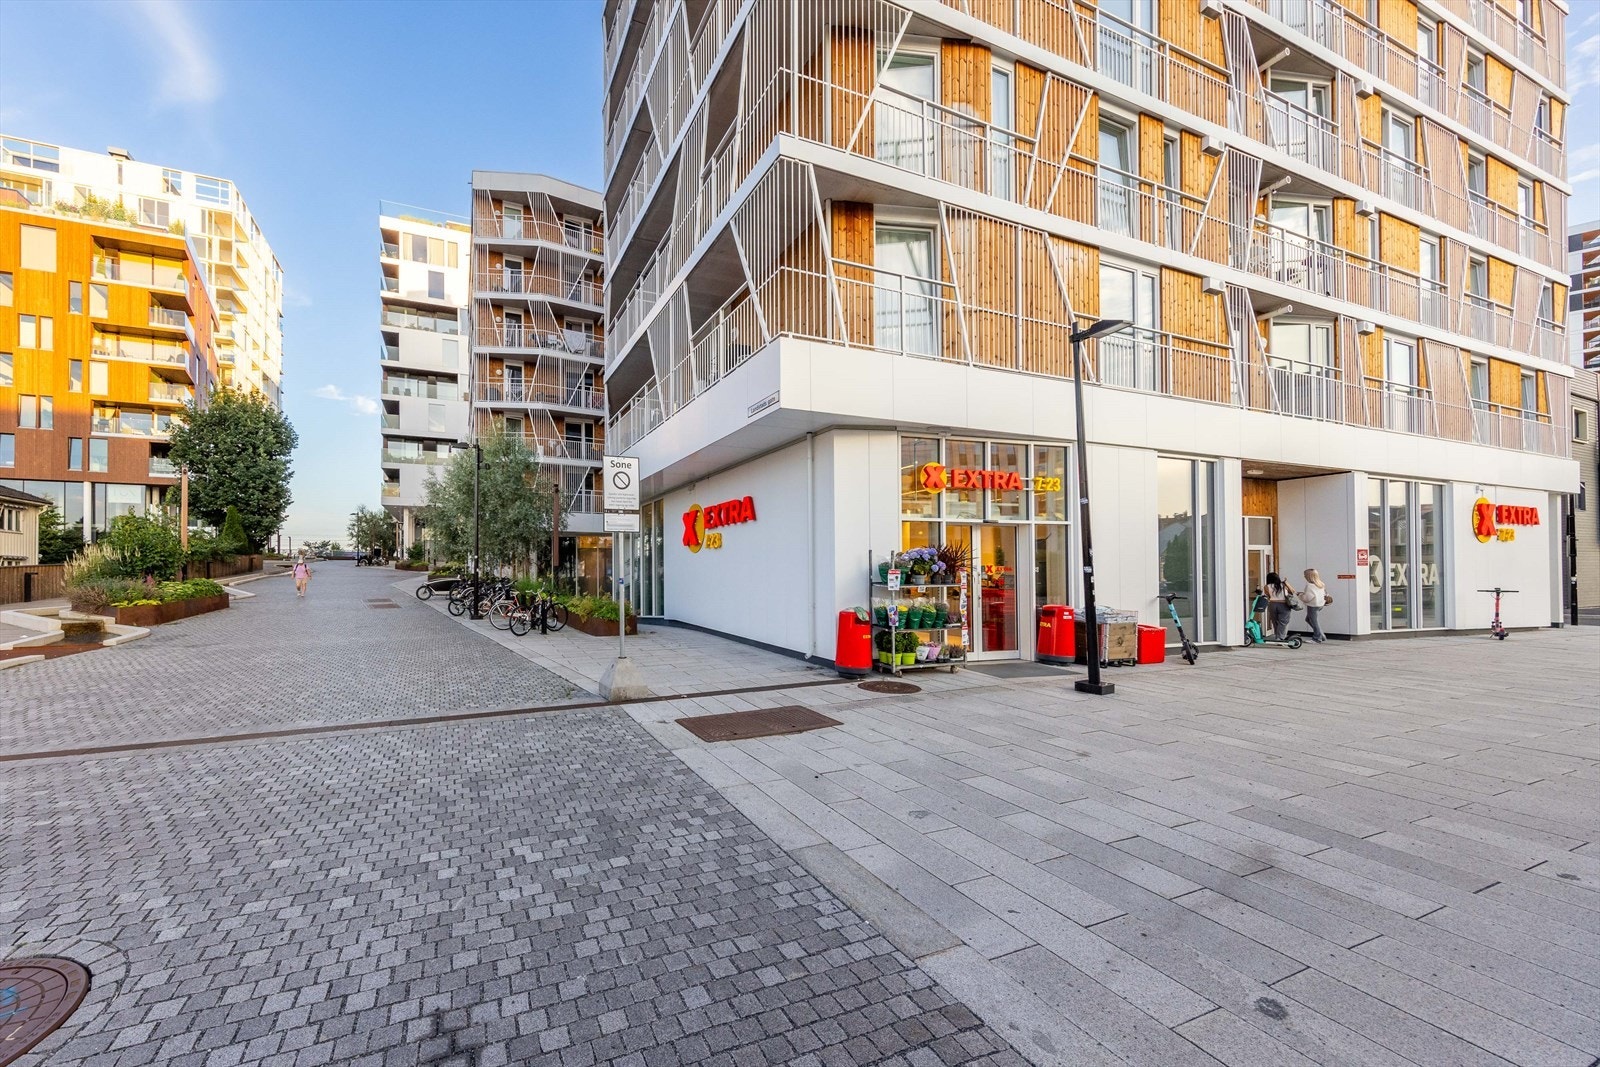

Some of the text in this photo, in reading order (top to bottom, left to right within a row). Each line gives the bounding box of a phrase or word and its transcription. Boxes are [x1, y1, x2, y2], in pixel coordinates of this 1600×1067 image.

[610, 460, 632, 469] Sone
[951, 469, 1023, 490] EXTRA
[1034, 477, 1061, 491] 7-23
[704, 496, 757, 529] EXTRA
[1497, 505, 1539, 526] EXTRA
[1391, 563, 1440, 586] EXRA
